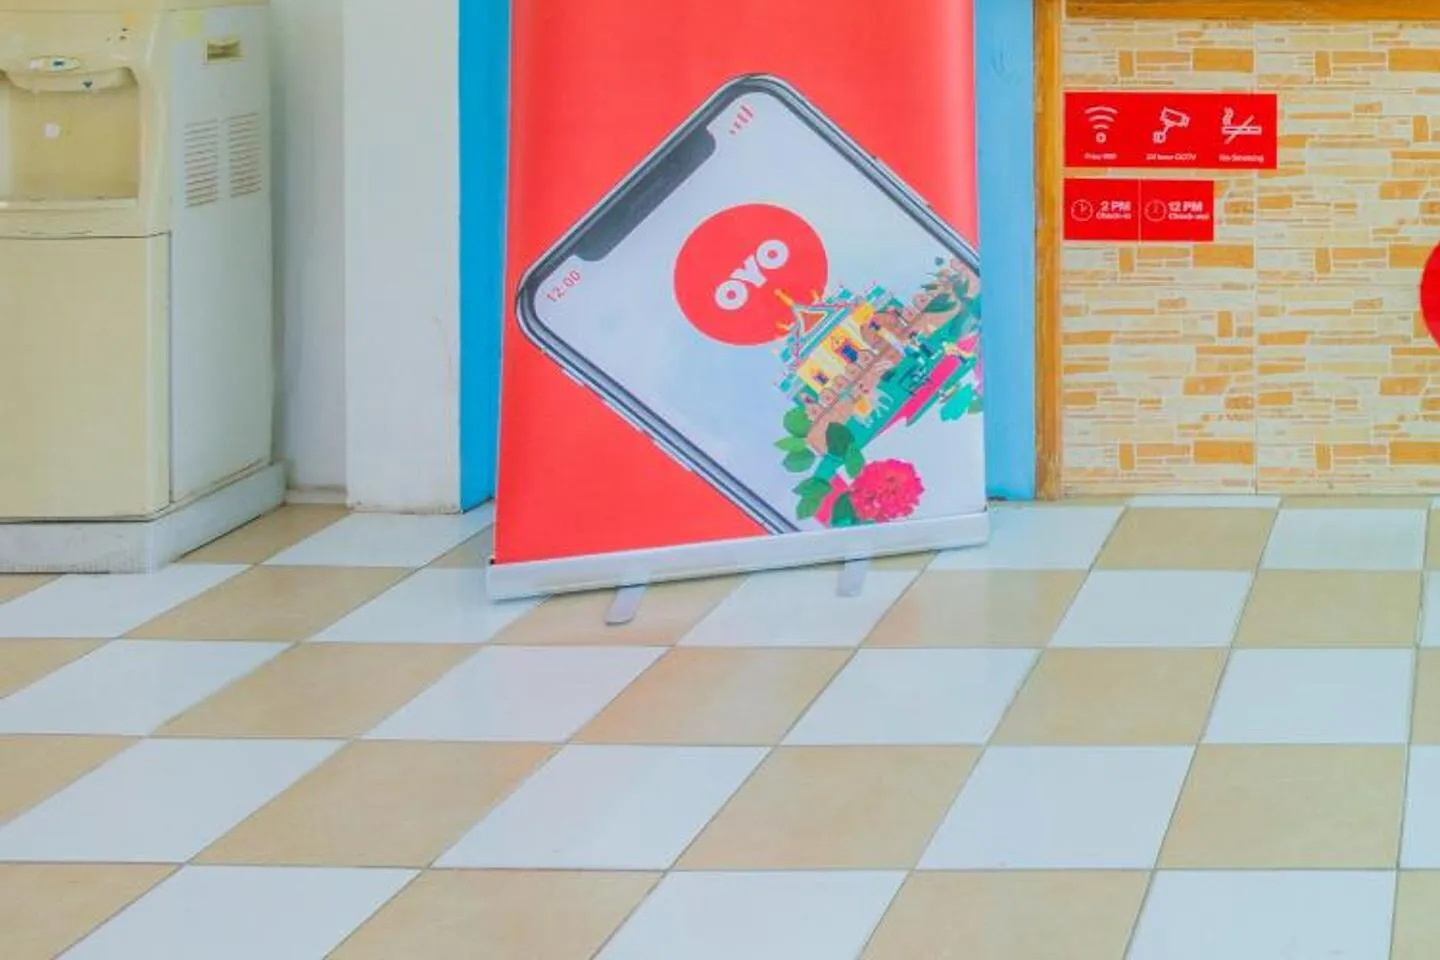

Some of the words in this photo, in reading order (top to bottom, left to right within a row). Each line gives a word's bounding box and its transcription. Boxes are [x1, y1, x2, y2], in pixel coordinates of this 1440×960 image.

[1100, 200, 1109, 212] 2
[1111, 200, 1132, 212] PM
[1167, 200, 1181, 212] 12
[1182, 200, 1204, 212] PM
[714, 239, 791, 311] OYO
